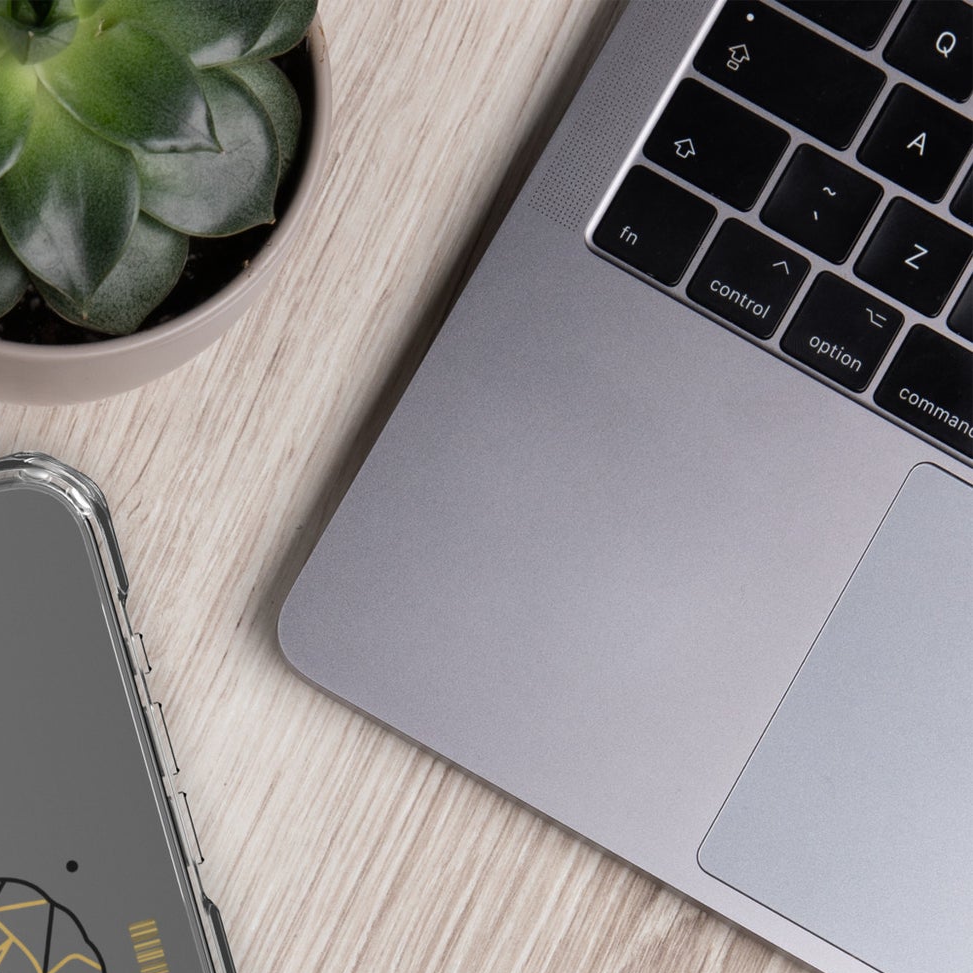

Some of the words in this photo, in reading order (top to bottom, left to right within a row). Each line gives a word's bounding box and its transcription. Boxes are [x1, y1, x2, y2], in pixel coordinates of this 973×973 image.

[935, 31, 956, 58] Q
[907, 132, 928, 156] A
[619, 225, 638, 246] fn
[904, 244, 928, 270] Z
[709, 278, 771, 319] control
[809, 334, 863, 372] option
